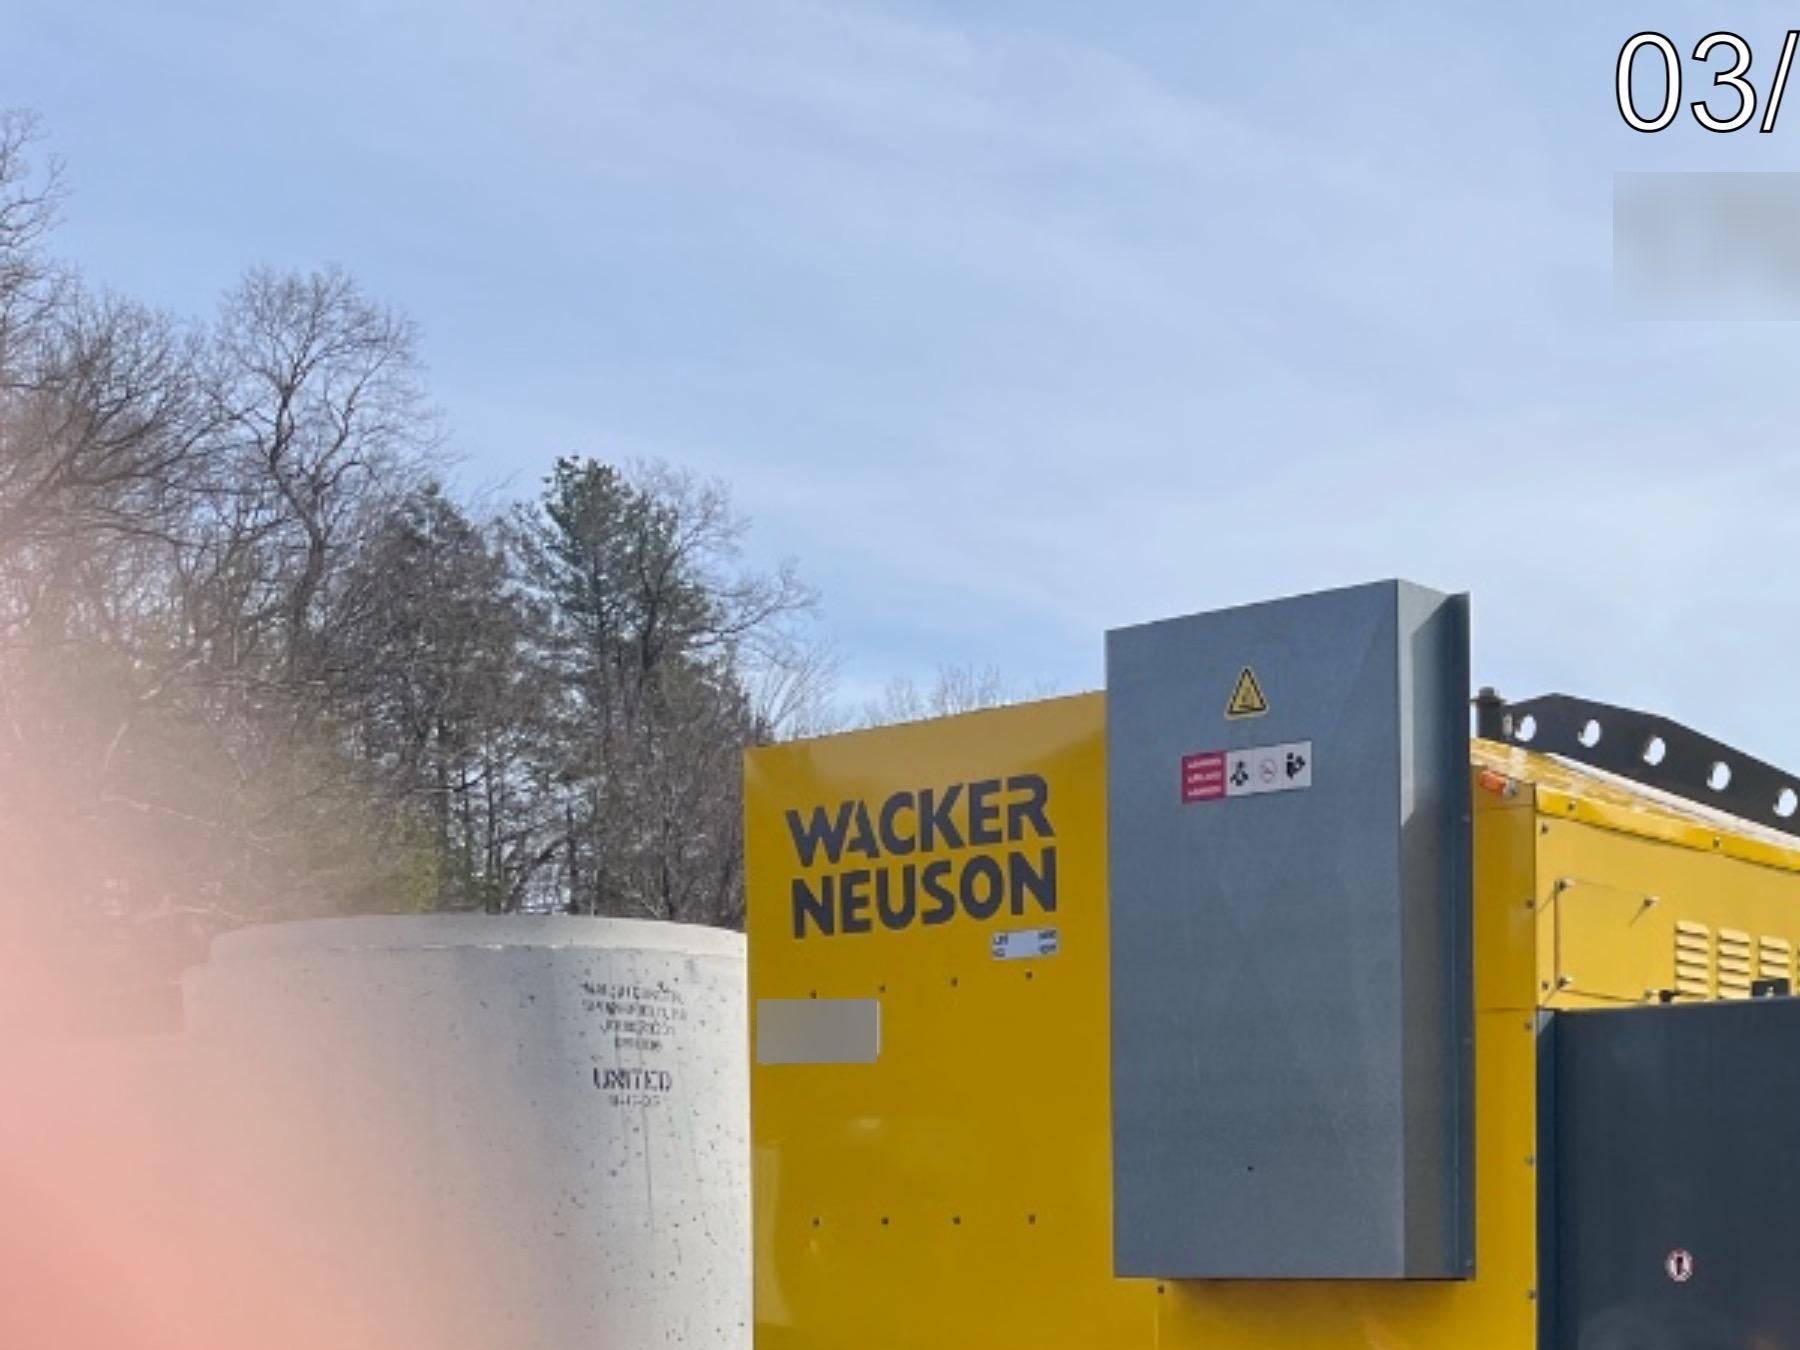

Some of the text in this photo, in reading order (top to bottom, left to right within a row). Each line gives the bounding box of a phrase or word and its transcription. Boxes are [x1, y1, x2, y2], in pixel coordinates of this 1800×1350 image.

[785, 774, 1056, 867] WACKER
[791, 846, 1057, 939] NEUSON
[592, 1067, 672, 1091] UNITED
